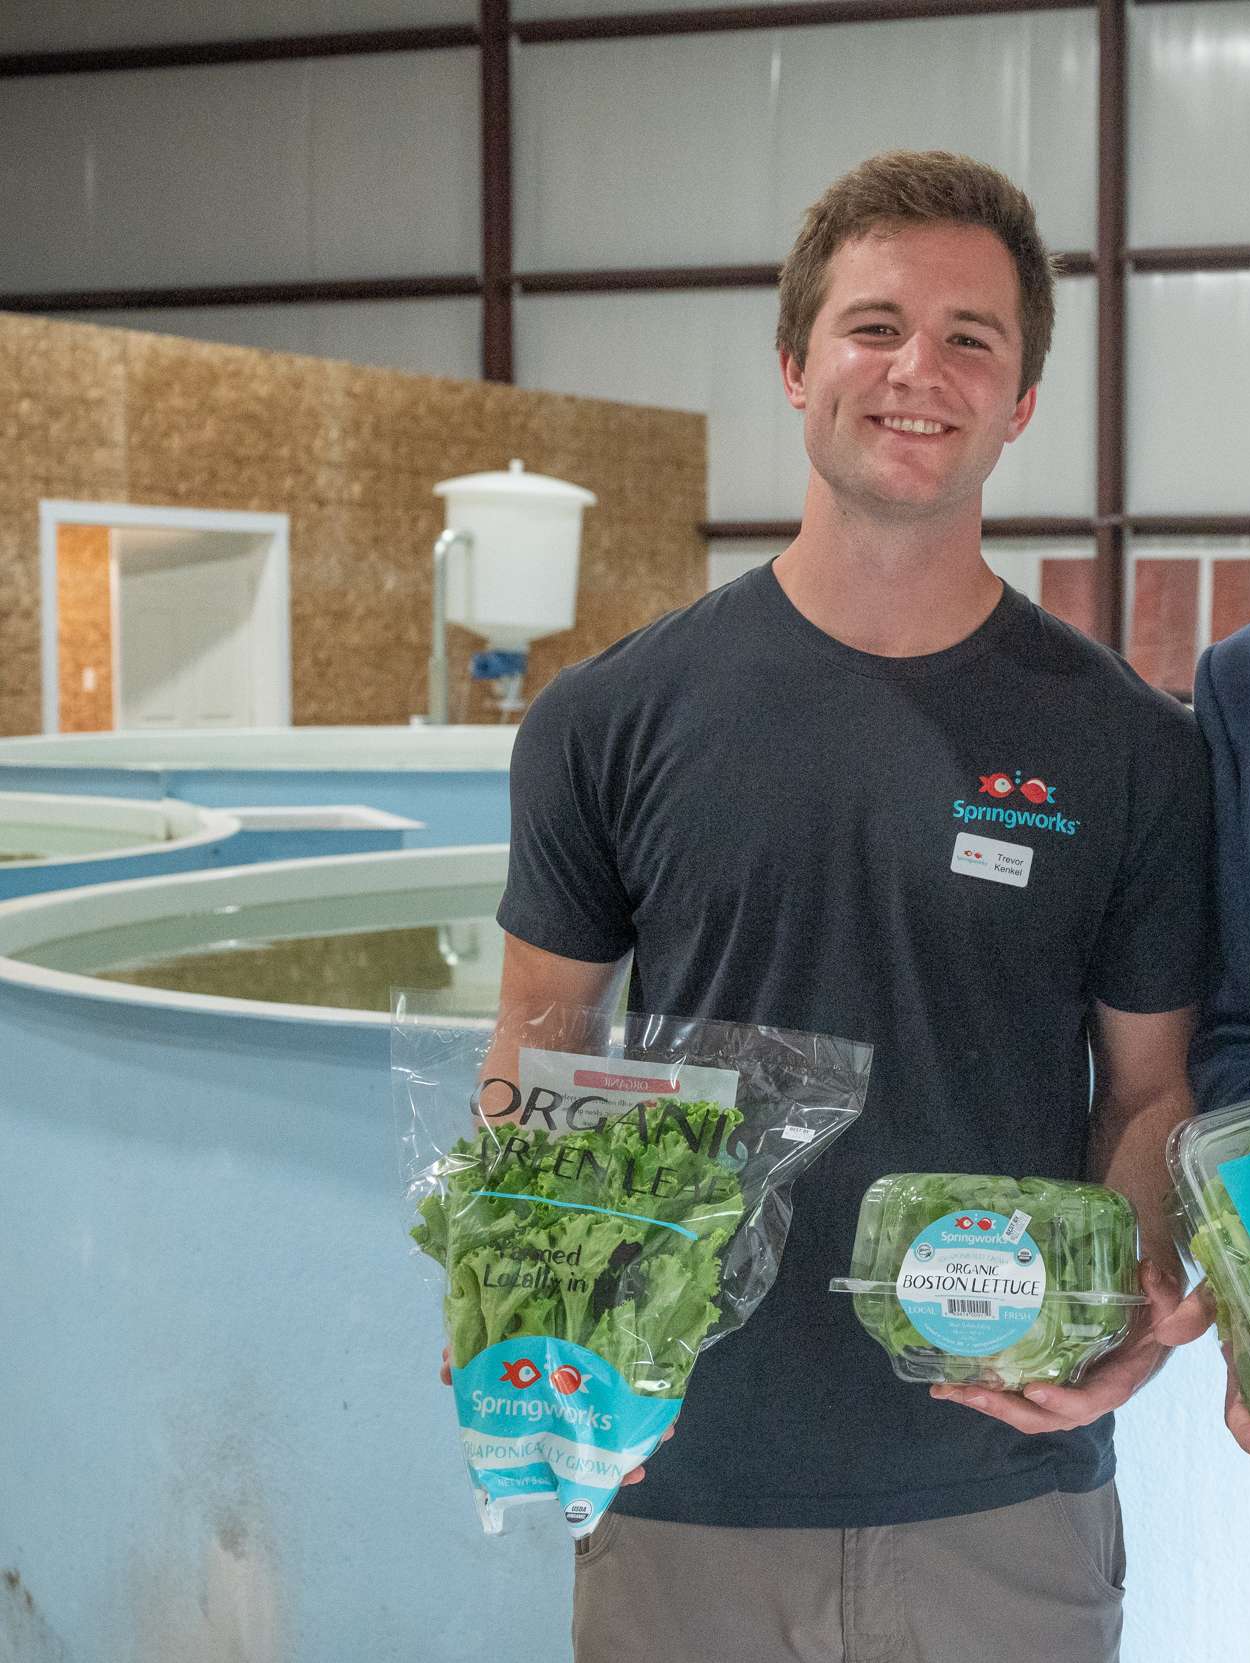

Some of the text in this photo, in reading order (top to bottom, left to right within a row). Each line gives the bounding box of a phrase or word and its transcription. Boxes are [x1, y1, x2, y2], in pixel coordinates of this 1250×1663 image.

[952, 799, 1077, 835] Springworks
[994, 864, 1023, 877] Kenkel
[997, 853, 1024, 867] Trevor
[470, 1078, 748, 1162] ORGANIC
[484, 1263, 562, 1297] Locally
[567, 1271, 586, 1294] in
[946, 1262, 1000, 1276] ORGANIC
[903, 1274, 1040, 1297] BOSTON LETTUCE
[909, 1306, 935, 1315] LOCAL
[472, 1390, 613, 1432] Springworks
[565, 1454, 625, 1478] GROWN
